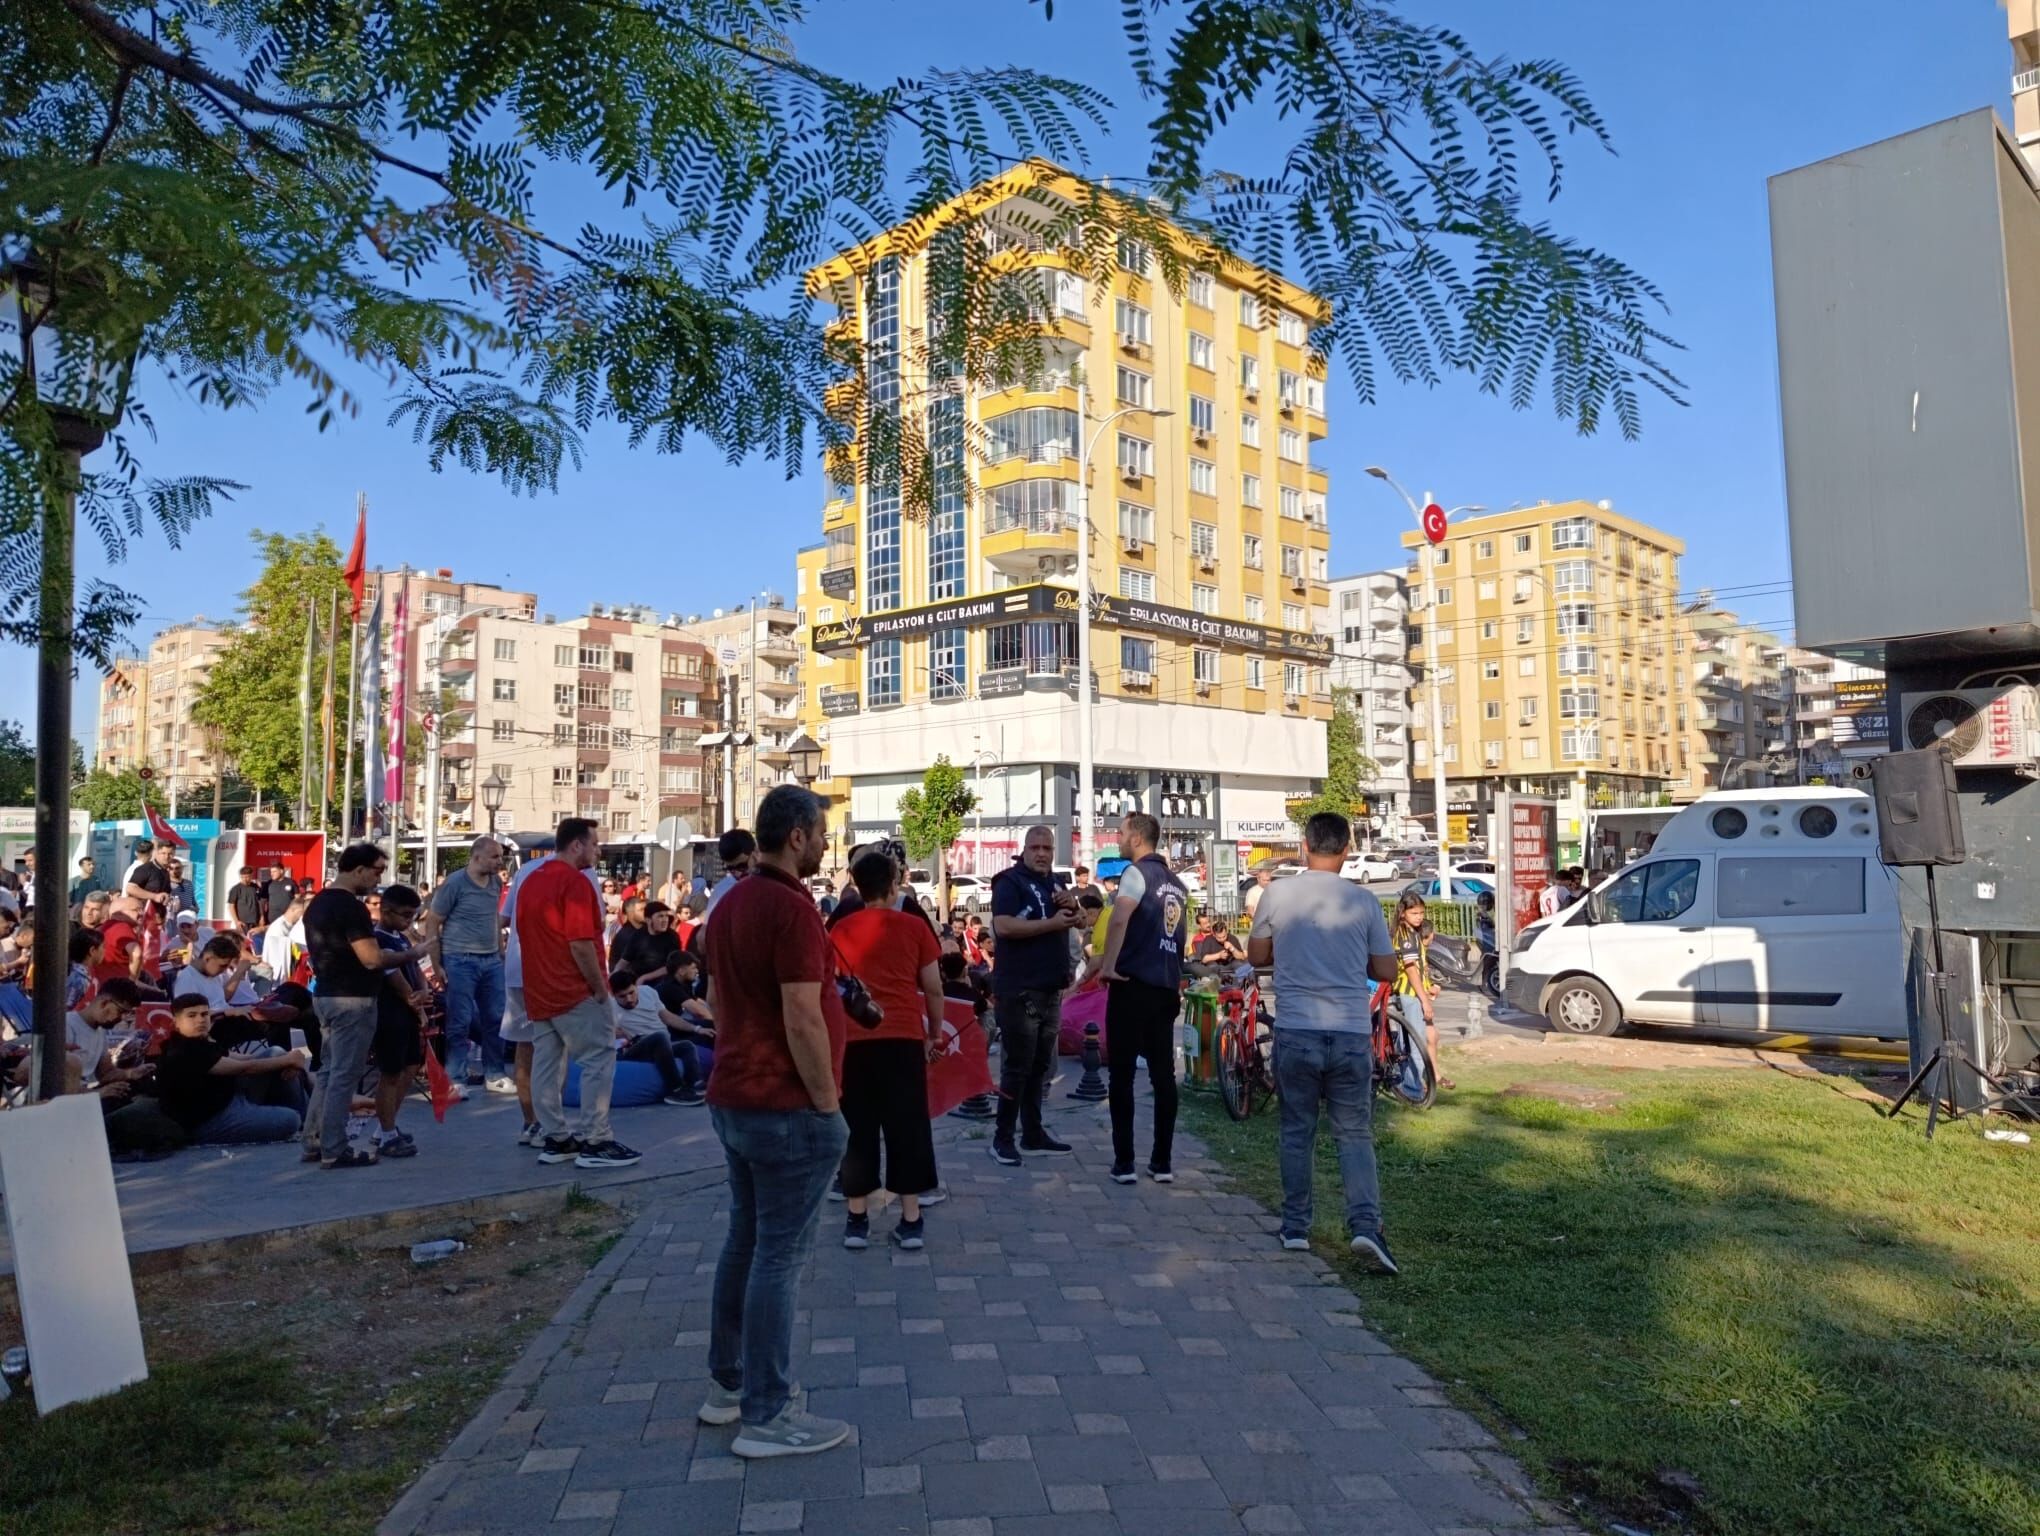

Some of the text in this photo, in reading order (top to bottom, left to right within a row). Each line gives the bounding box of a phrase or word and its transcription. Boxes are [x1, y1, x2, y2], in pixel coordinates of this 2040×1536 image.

[927, 613, 934, 624] &
[958, 601, 994, 619] BAKIMI
[1191, 618, 1199, 632] &
[1224, 625, 1260, 642] BAKIMI
[1993, 696, 2011, 757] VESTEL
[178, 823, 199, 832] TAM
[1073, 813, 1105, 828] nta
[256, 850, 293, 858] AKBANK
